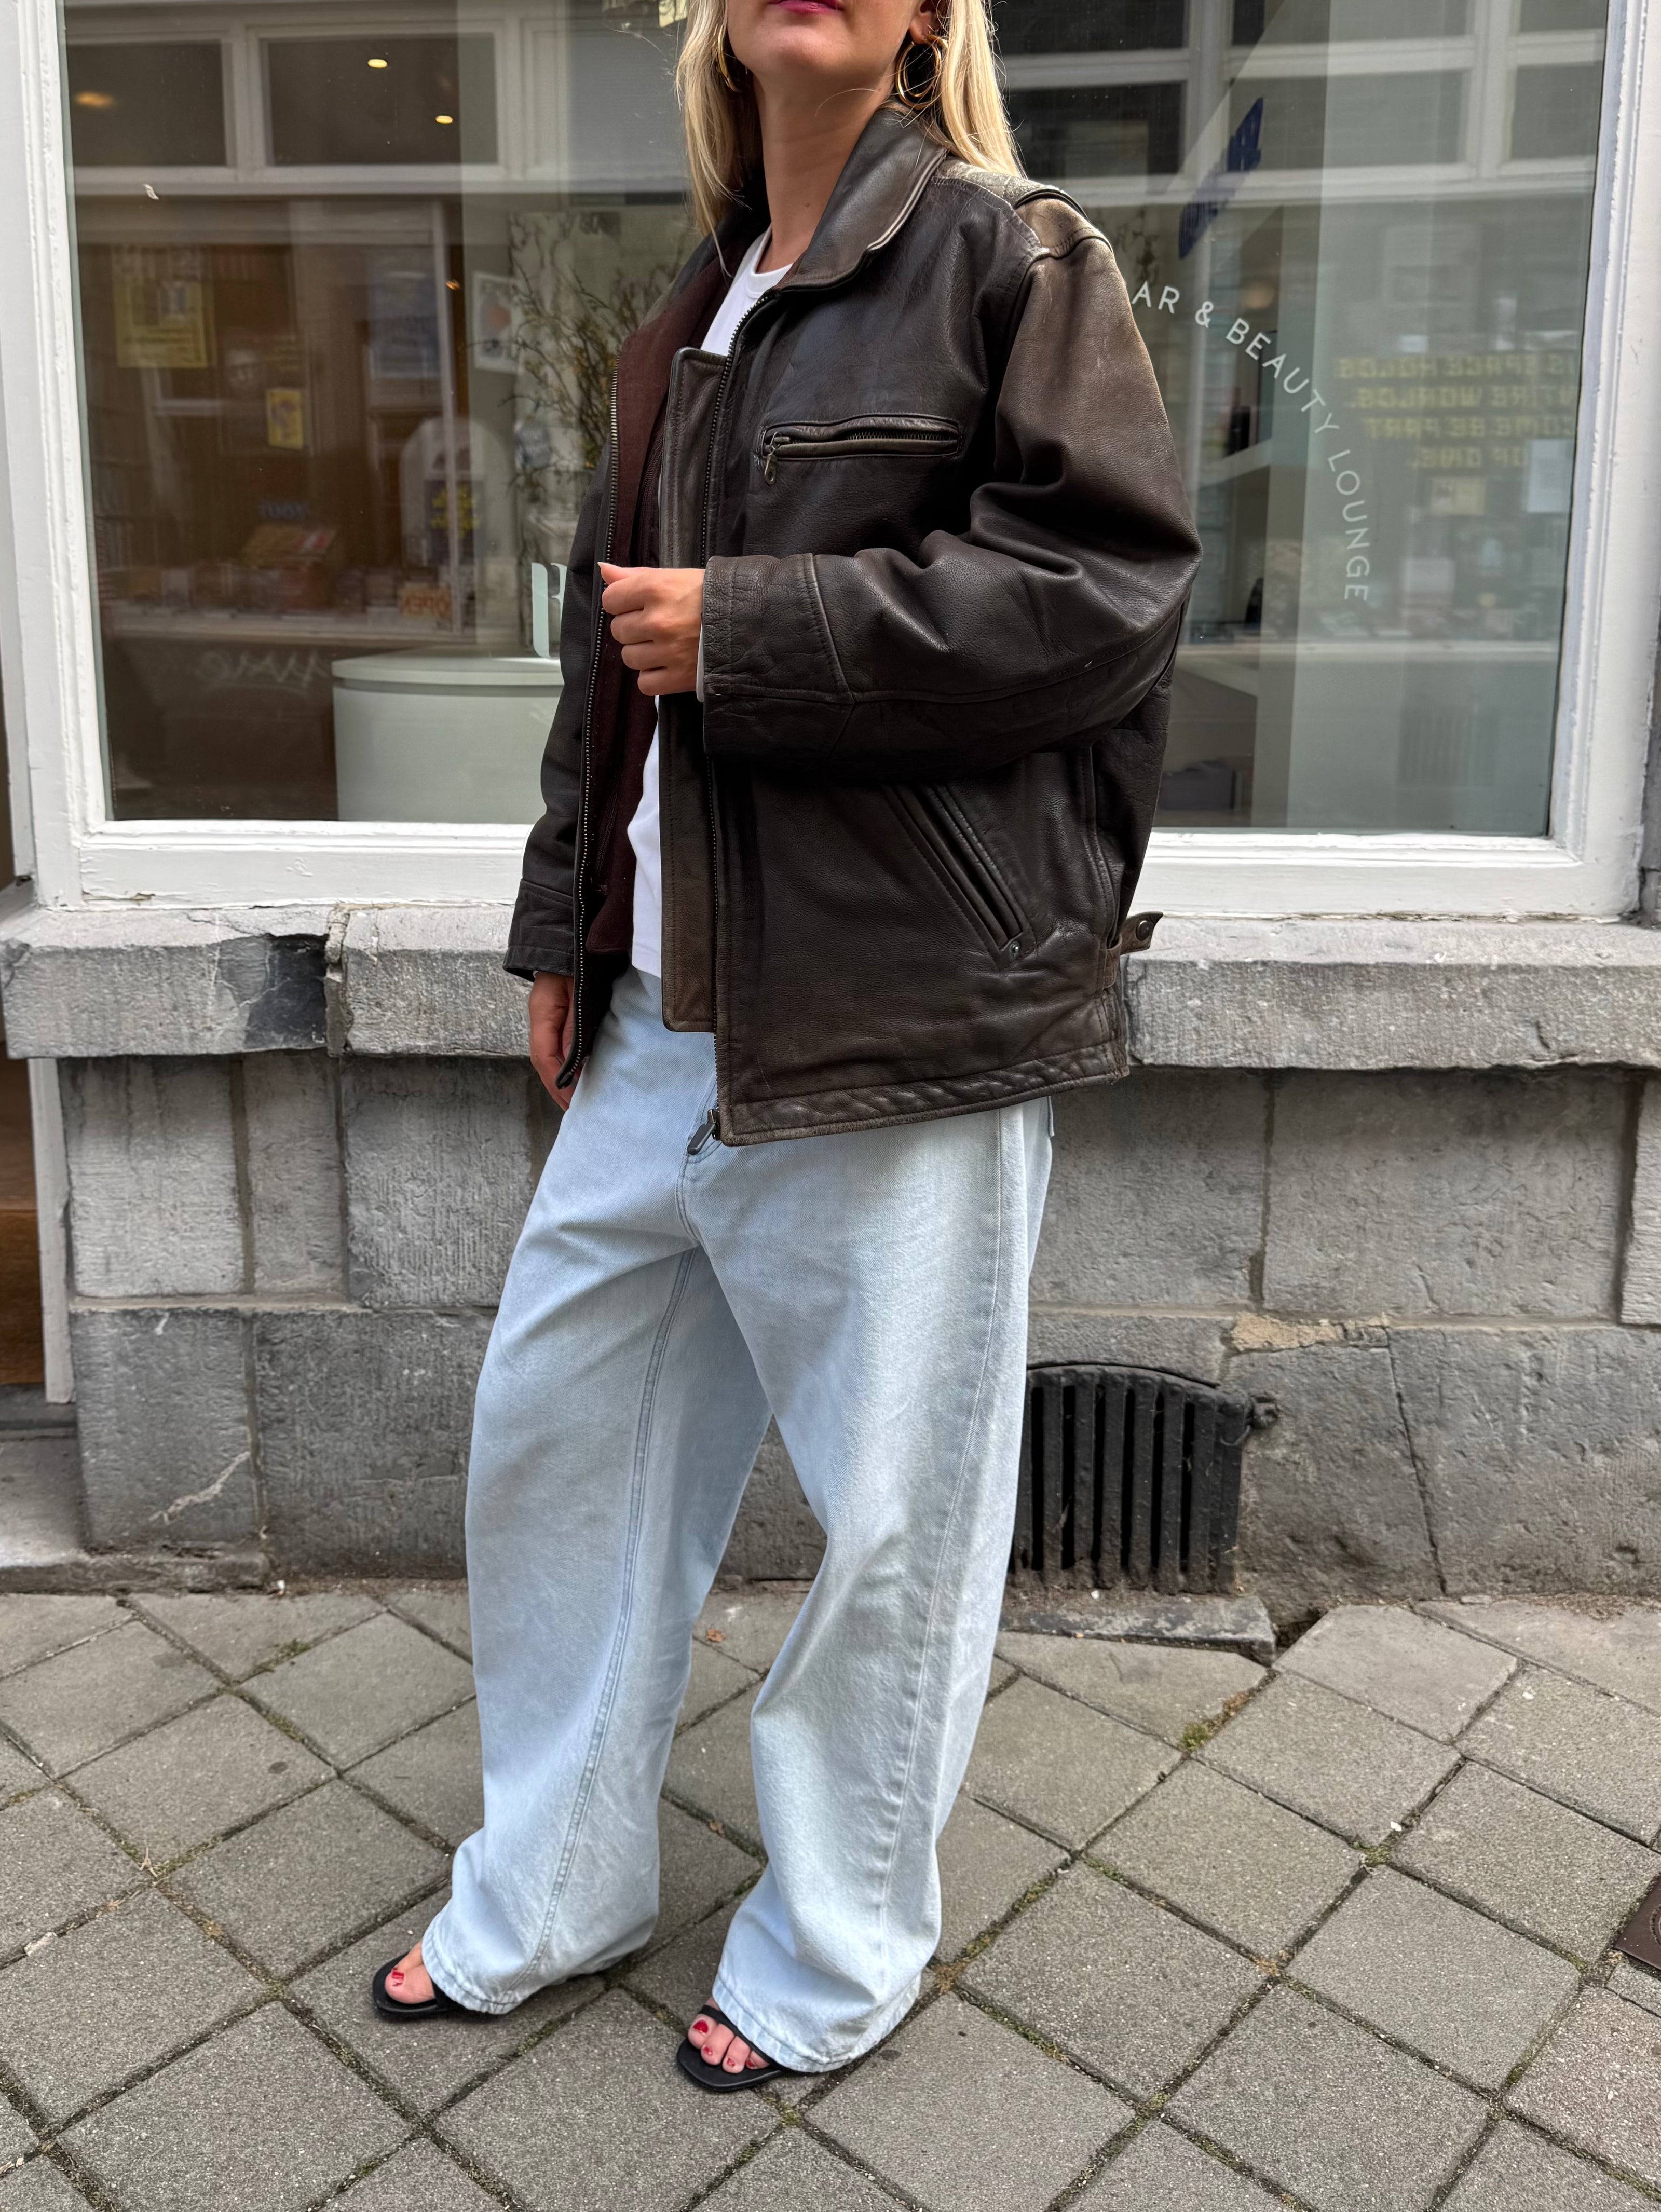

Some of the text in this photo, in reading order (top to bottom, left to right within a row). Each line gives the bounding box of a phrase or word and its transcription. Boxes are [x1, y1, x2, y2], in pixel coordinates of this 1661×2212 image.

[1131, 281, 1370, 602] AR & BEAUTY LOUNGE
